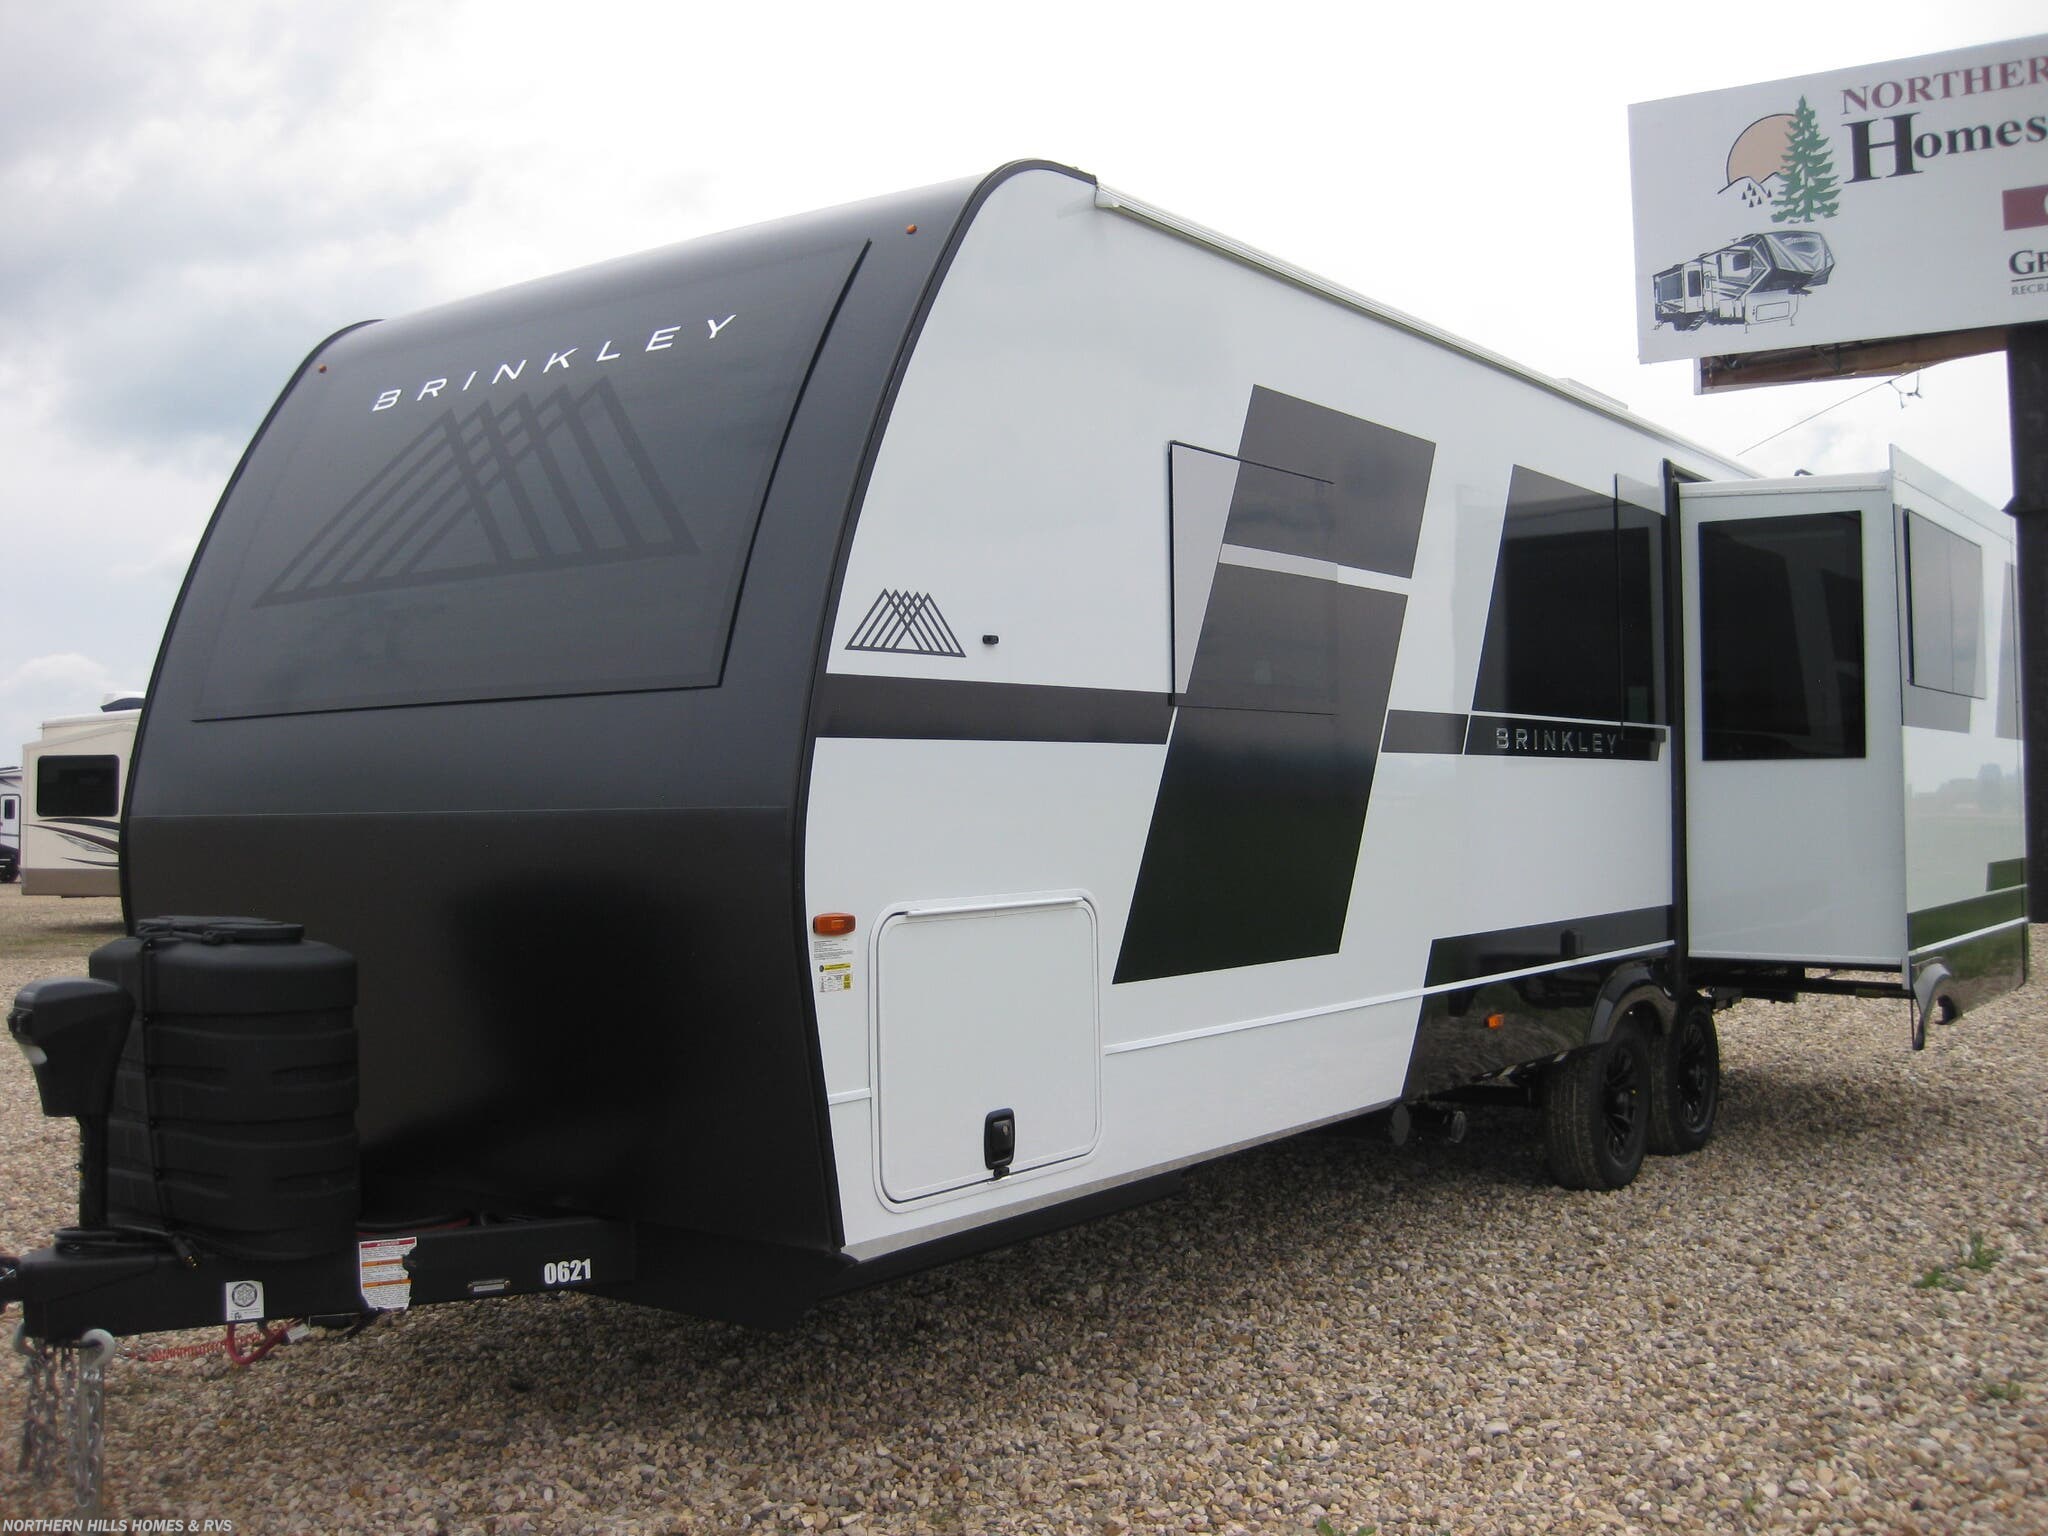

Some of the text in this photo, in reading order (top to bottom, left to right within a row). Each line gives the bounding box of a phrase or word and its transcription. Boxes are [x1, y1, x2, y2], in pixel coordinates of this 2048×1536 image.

[1840, 56, 2048, 115] NORTHER
[1841, 112, 2047, 184] Homes
[2010, 283, 2048, 296] RECR
[372, 313, 737, 413] BRINKLEY
[1495, 727, 1617, 754] BRINKLEY
[544, 1258, 591, 1284] 0621
